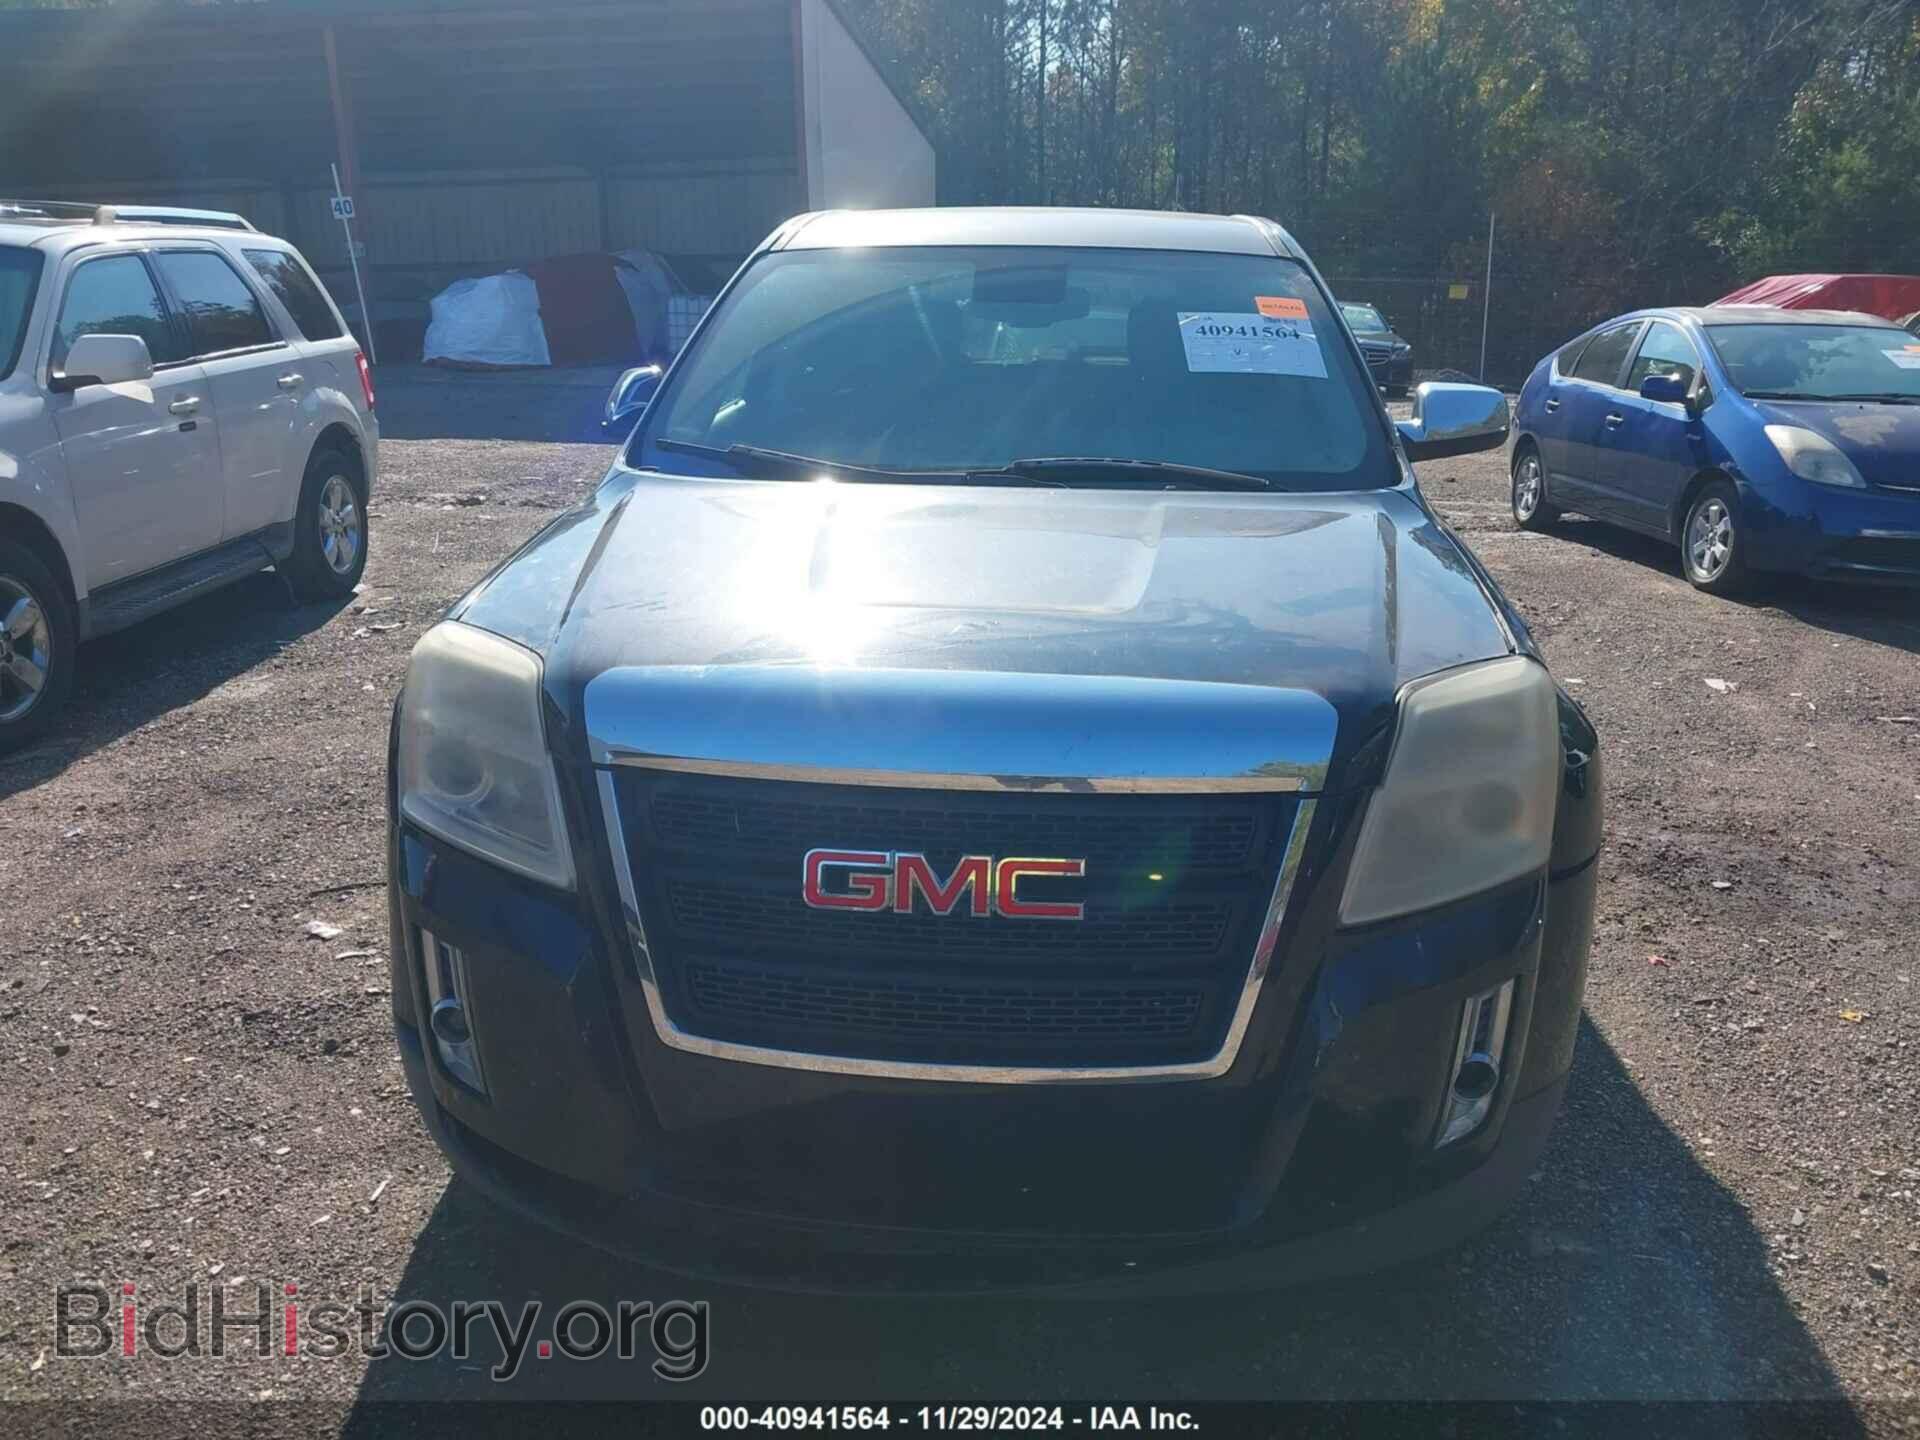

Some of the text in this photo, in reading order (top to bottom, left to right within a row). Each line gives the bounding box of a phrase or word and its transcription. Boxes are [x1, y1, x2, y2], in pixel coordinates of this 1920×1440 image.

[334, 200, 353, 215] 40
[1195, 325, 1301, 340] 40941564
[803, 848, 1086, 920] GMC
